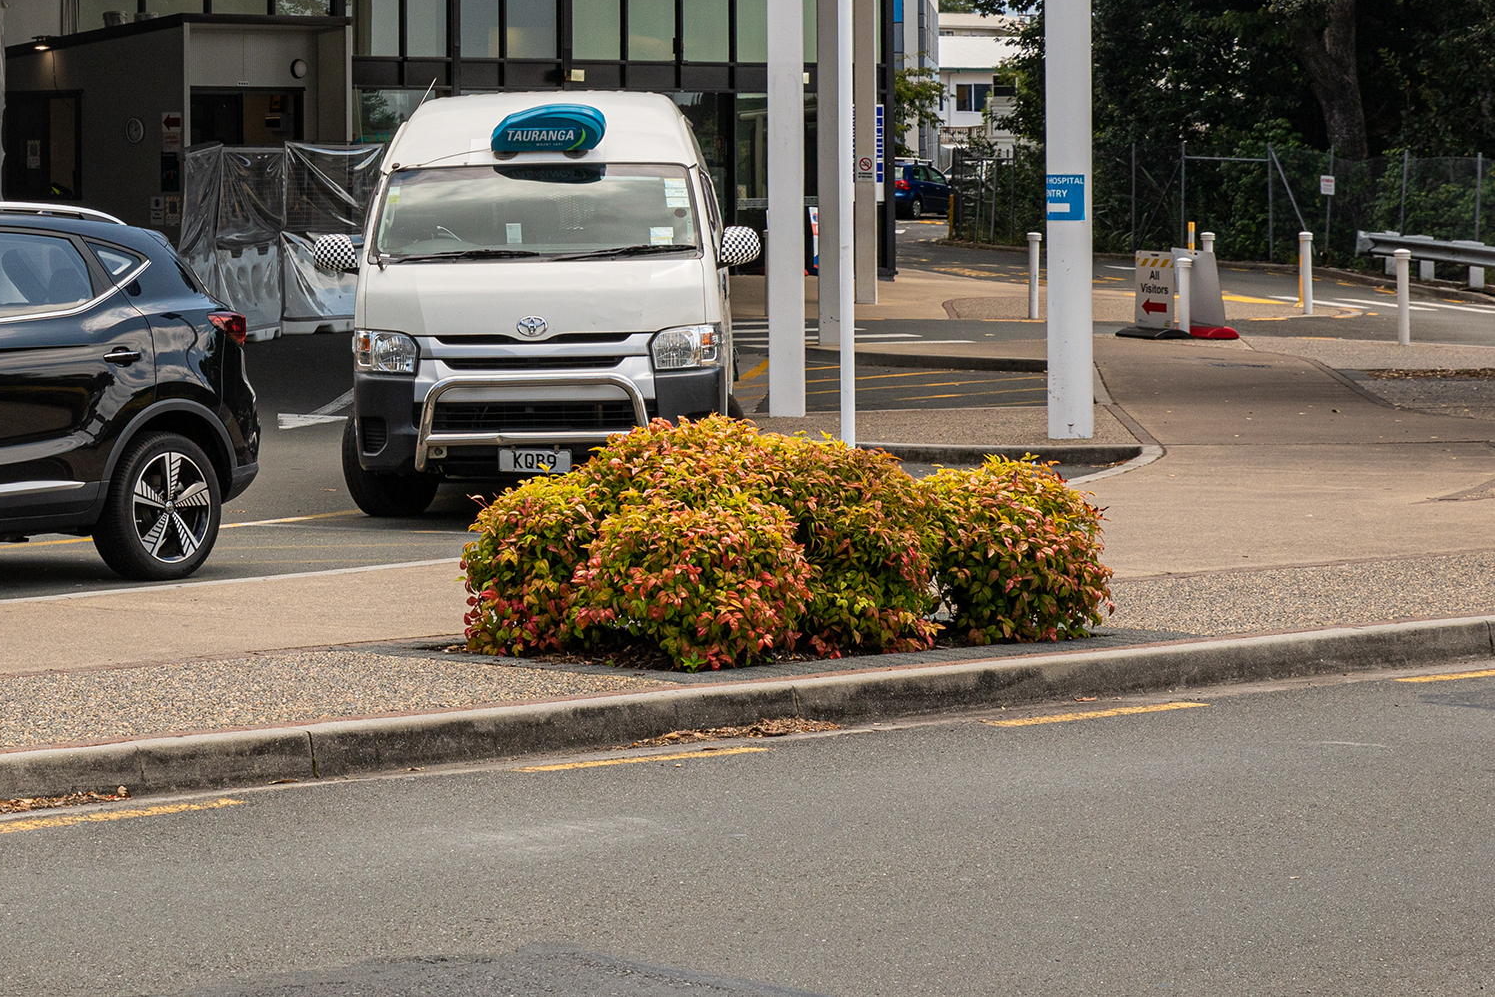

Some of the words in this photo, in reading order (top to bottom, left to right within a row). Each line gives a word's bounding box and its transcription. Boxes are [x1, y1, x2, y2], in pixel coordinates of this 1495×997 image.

[507, 130, 574, 141] TAURANGA
[1150, 270, 1160, 280] All
[1140, 283, 1169, 295] Visitors
